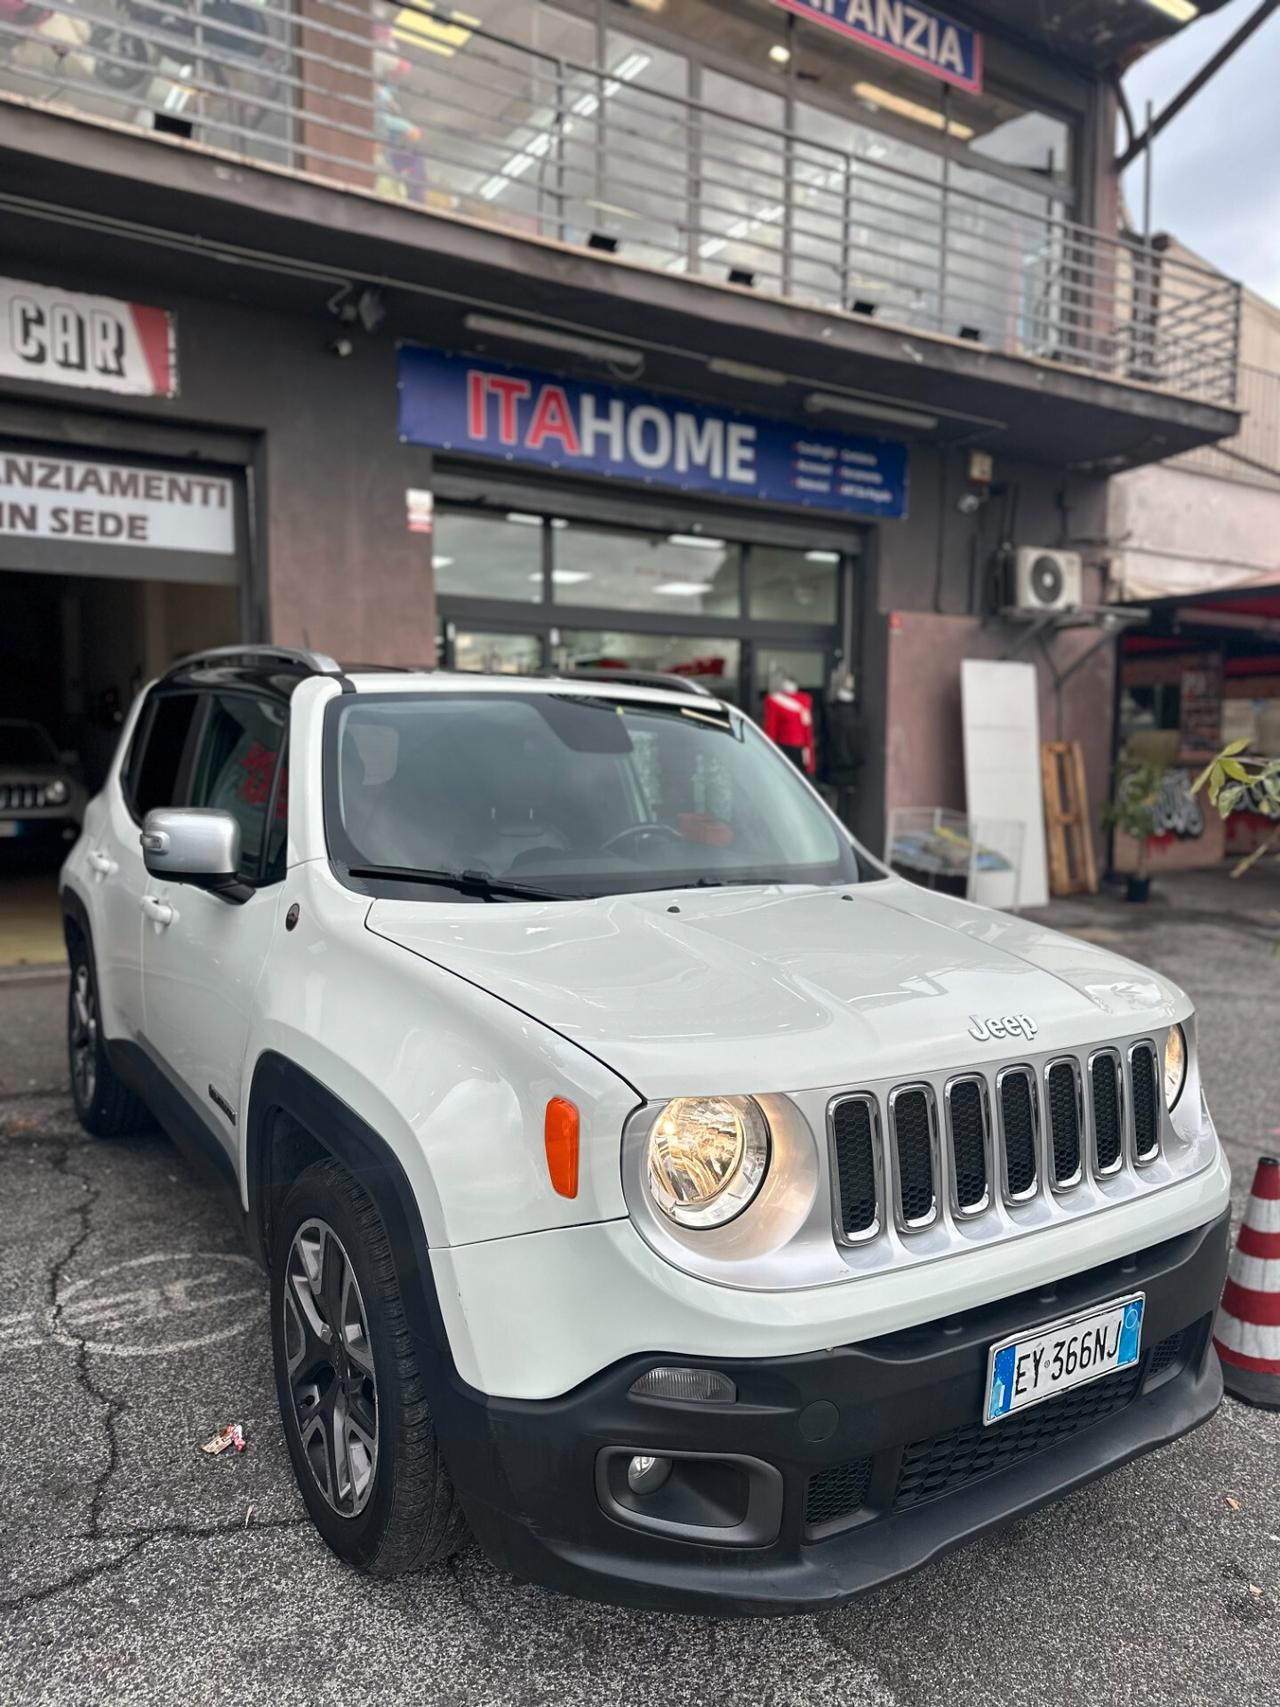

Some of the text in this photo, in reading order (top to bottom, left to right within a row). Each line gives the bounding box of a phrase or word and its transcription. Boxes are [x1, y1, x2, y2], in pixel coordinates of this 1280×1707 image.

[9, 296, 127, 379] CAR
[467, 369, 757, 484] ITAHOME
[50, 507, 149, 541] SEDE
[967, 1014, 1039, 1042] Jeep
